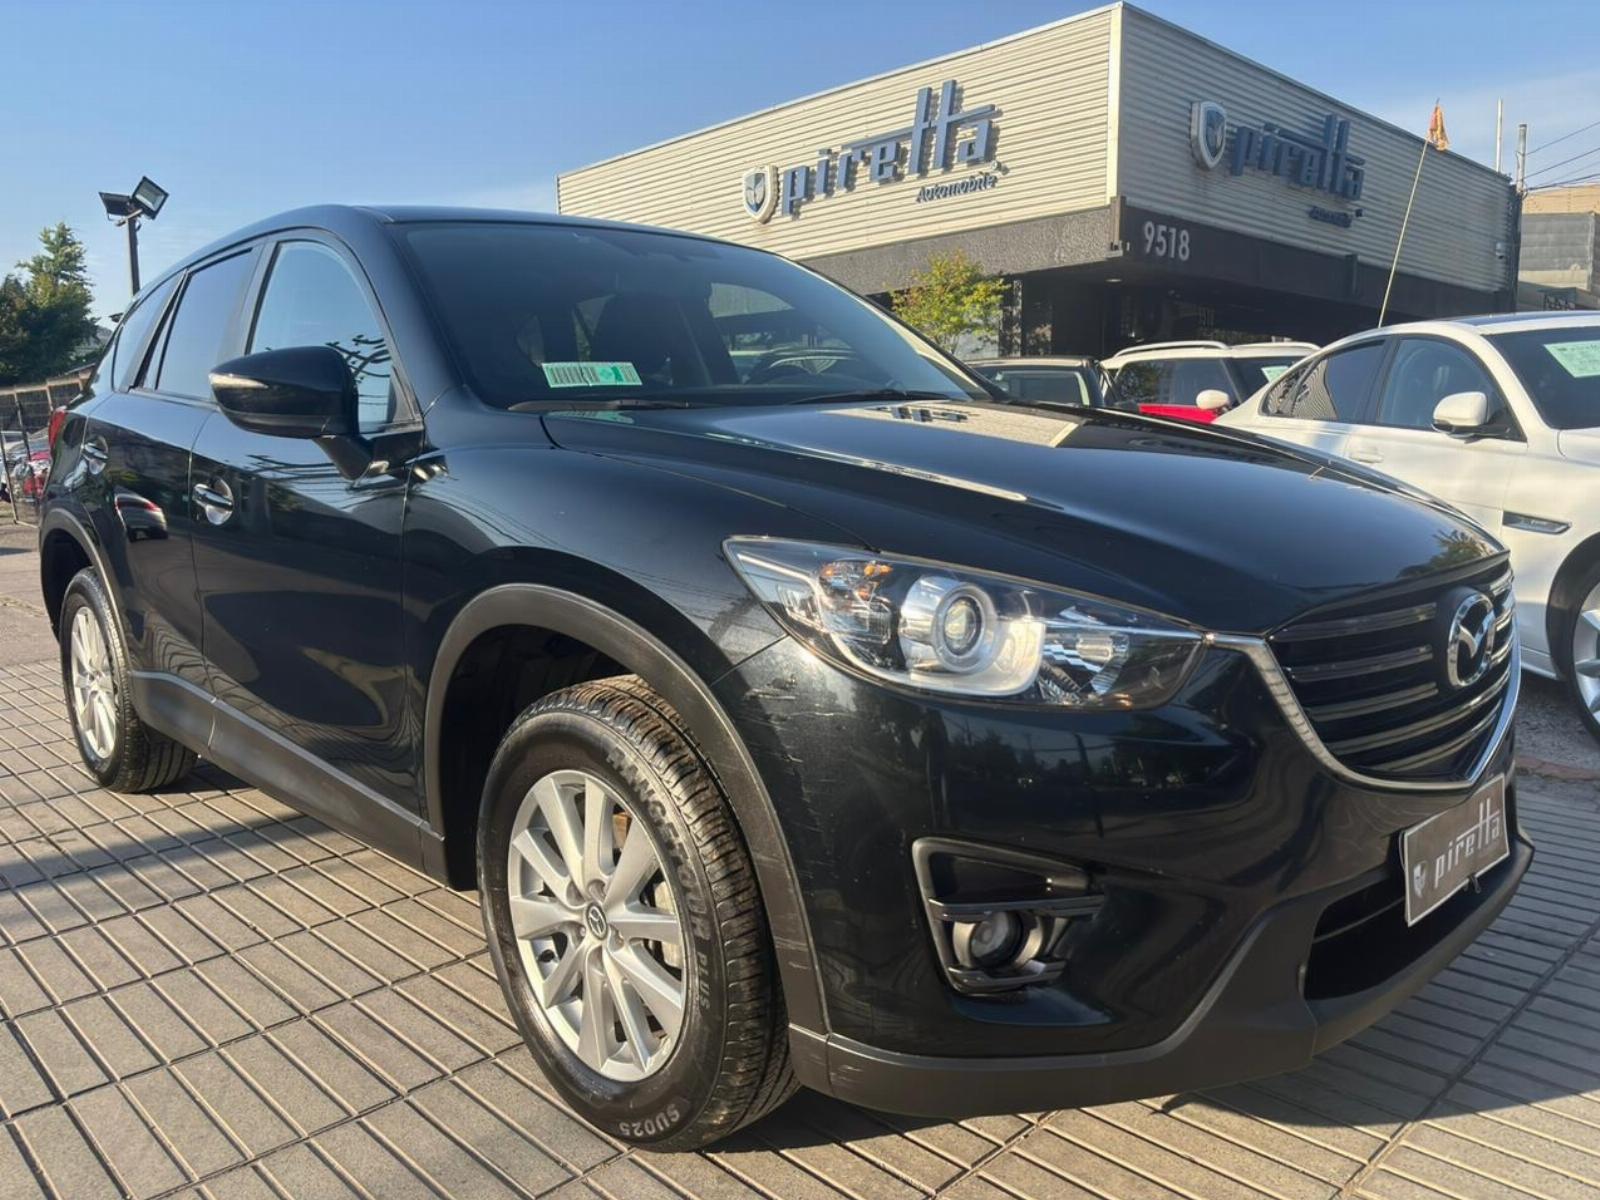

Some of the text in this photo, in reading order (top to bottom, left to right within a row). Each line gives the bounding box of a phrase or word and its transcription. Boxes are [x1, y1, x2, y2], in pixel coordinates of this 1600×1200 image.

[781, 79, 997, 217] piretta
[1144, 221, 1190, 261] 9518
[1434, 798, 1500, 889] piretta
[697, 951, 712, 1009] PLUS
[618, 1103, 681, 1137] SU025
